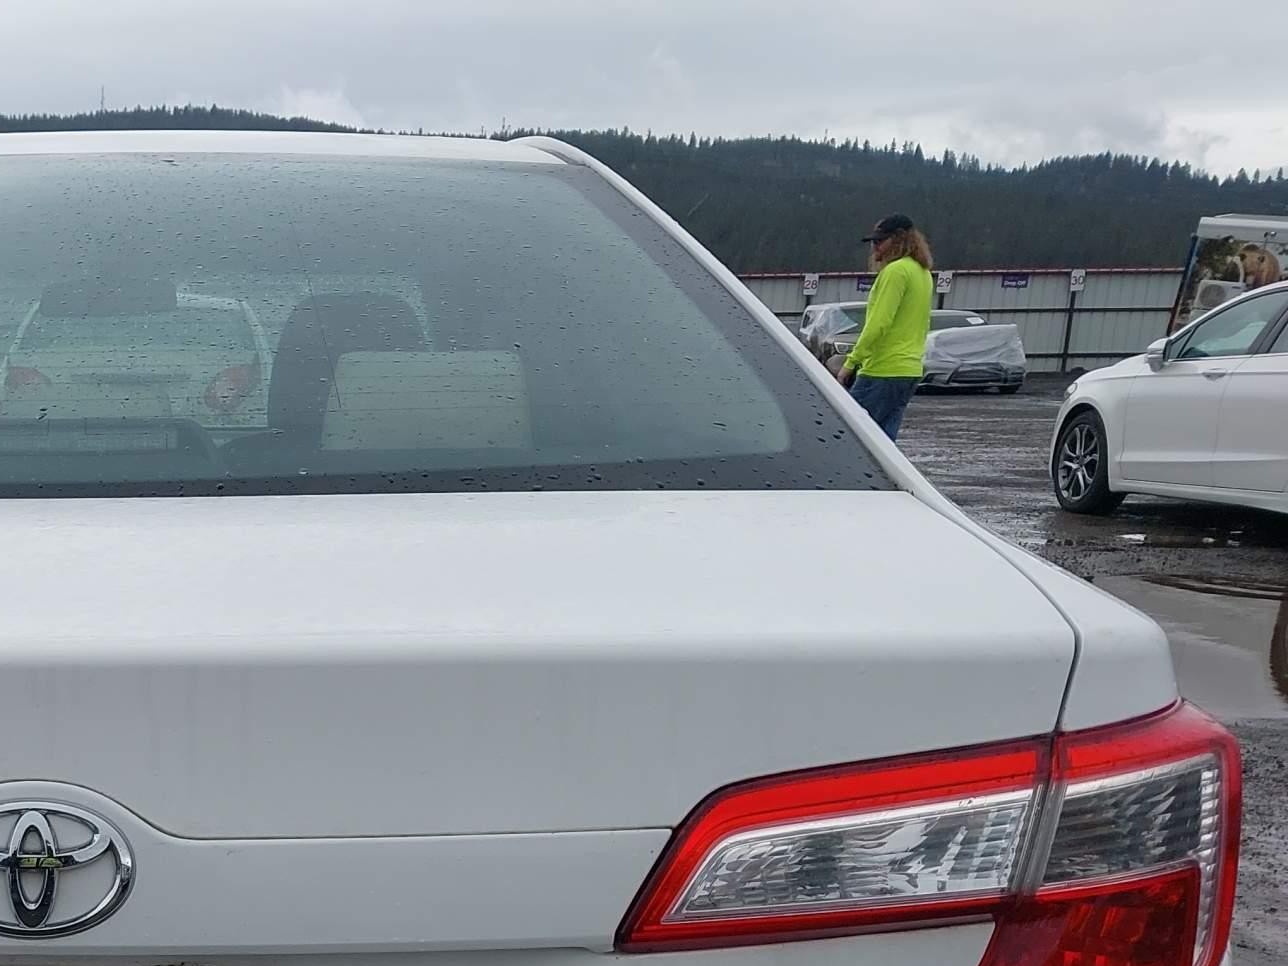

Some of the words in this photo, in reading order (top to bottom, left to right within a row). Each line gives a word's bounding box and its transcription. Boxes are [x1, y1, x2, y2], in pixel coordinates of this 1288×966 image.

[804, 279, 818, 290] 28
[938, 277, 951, 288] 29
[1071, 275, 1085, 286] 30
